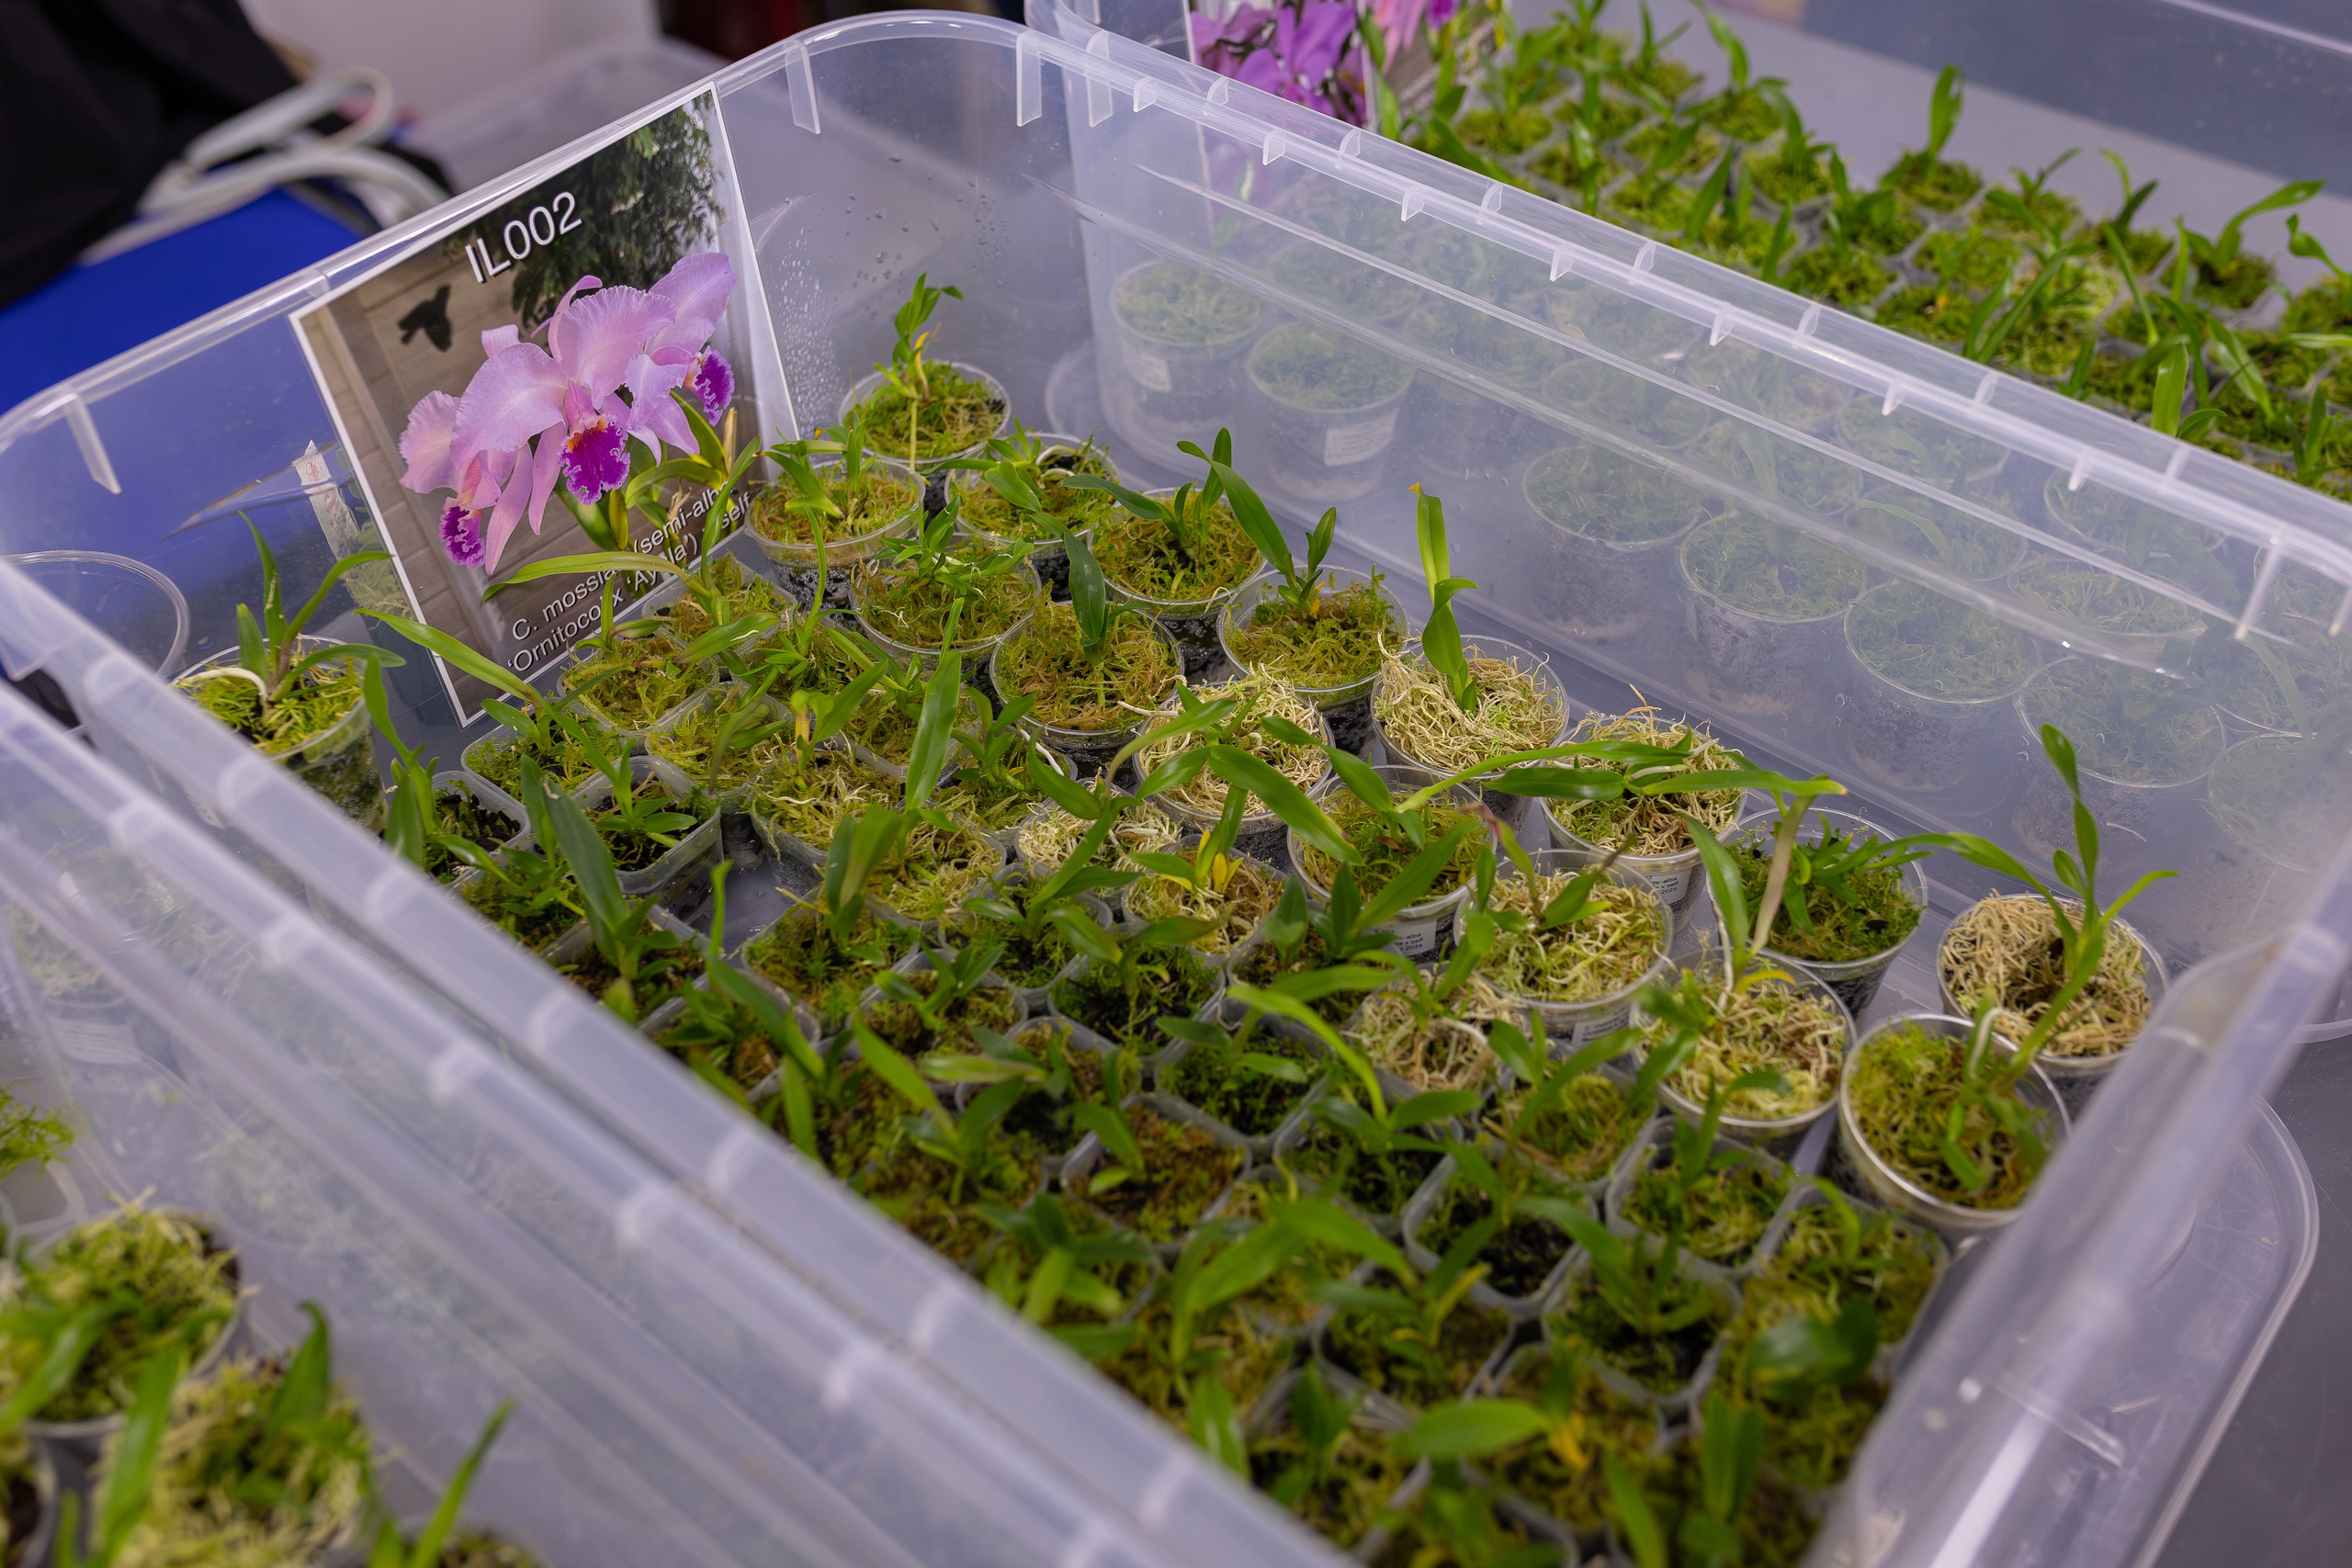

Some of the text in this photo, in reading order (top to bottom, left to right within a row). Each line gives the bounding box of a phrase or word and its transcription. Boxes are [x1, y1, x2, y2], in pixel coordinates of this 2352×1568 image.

[464, 191, 583, 284] IL002
[721, 491, 750, 530] self
[512, 617, 539, 641] C.
[633, 480, 734, 554] (semi-alb
